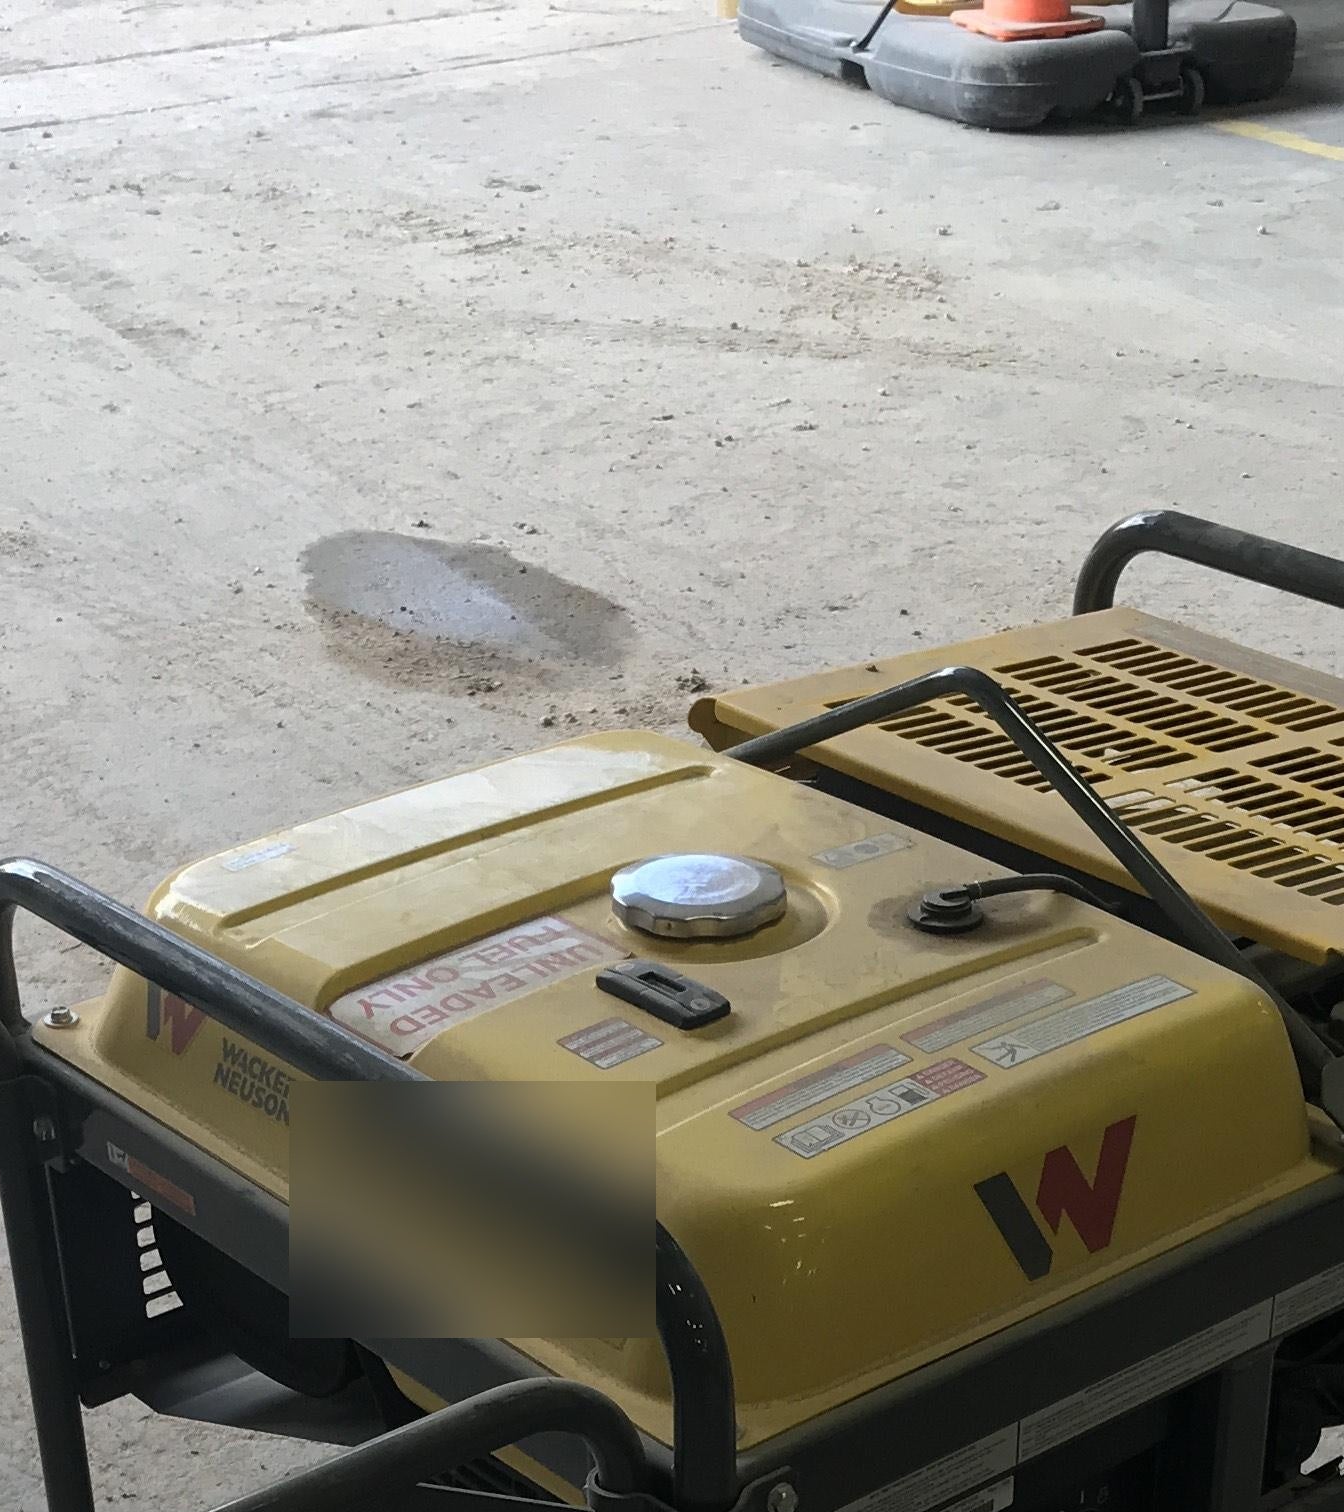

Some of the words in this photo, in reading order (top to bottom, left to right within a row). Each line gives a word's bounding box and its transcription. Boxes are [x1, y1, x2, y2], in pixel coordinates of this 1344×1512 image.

[460, 924, 565, 967] FUEL
[356, 966, 459, 1020] ONLY
[389, 943, 603, 1036] UNLEADED
